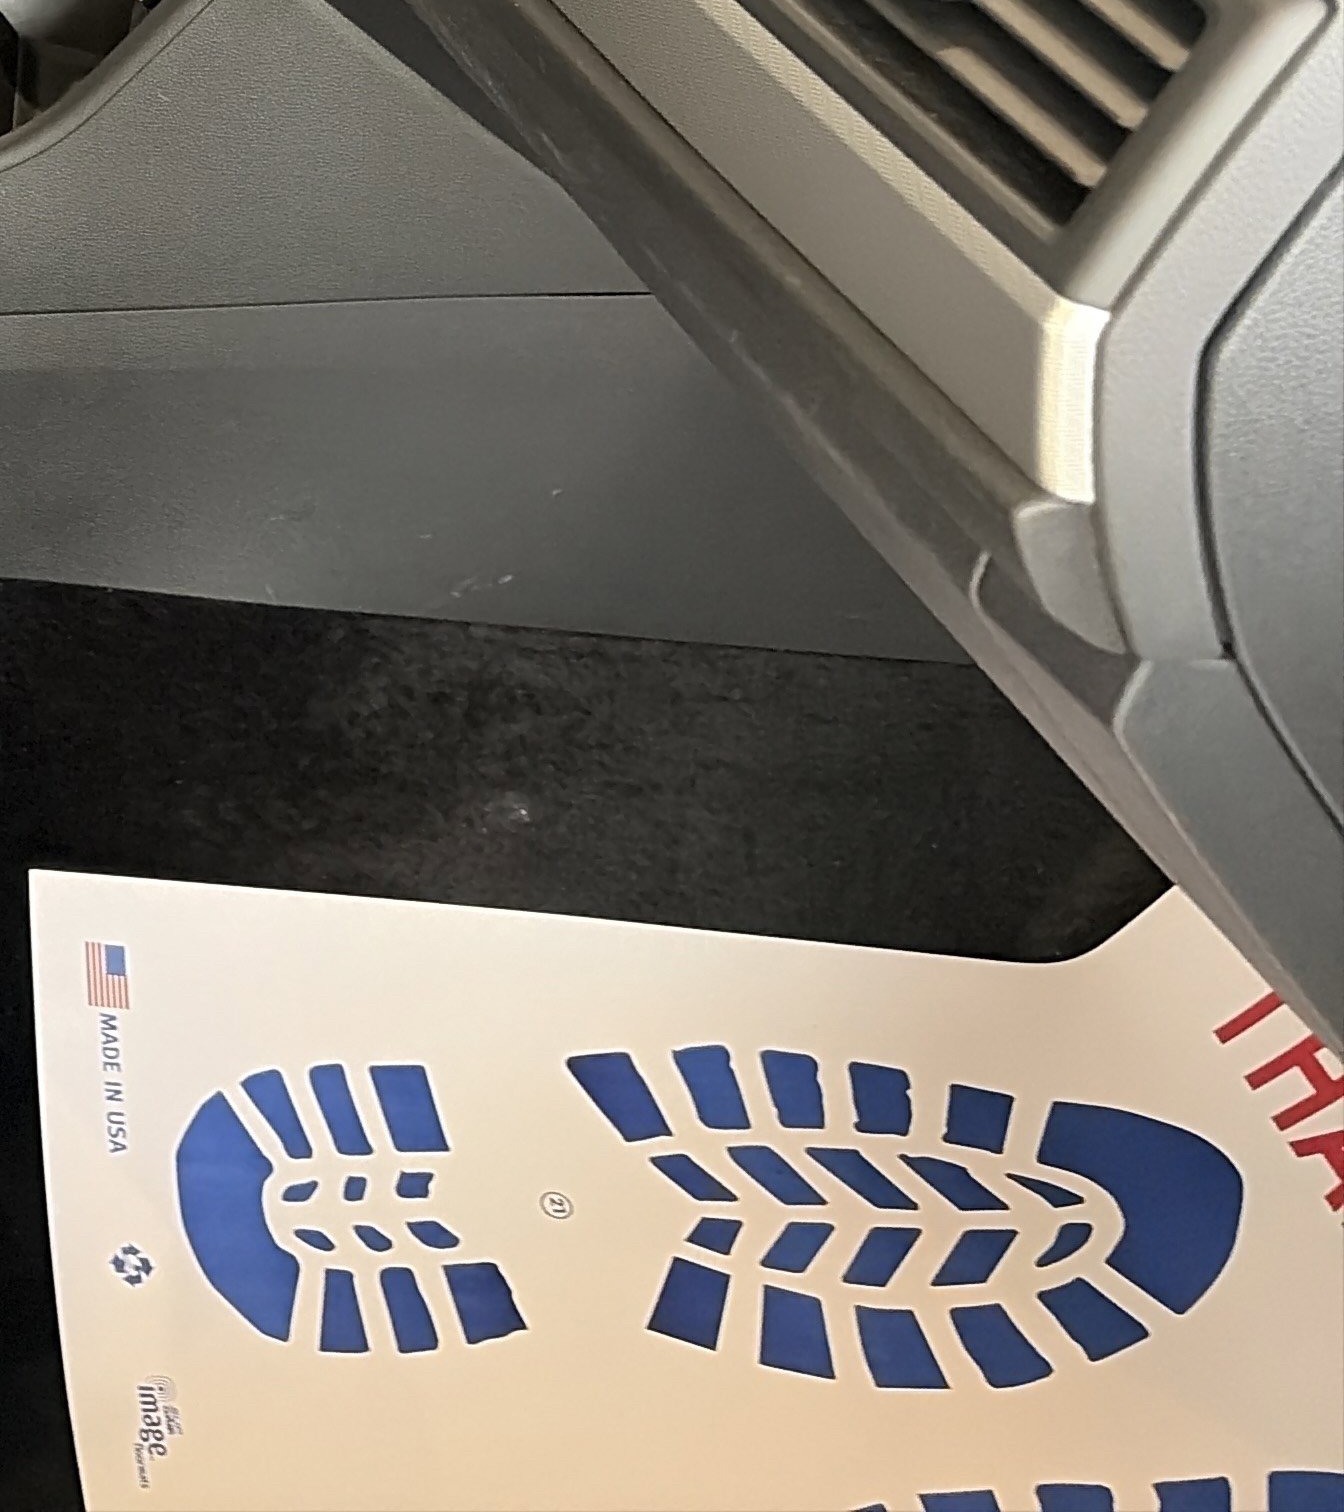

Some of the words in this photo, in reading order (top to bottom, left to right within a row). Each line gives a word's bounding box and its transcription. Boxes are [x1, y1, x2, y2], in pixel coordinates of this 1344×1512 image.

[99, 1012, 122, 1073] MADE
[104, 1081, 125, 1103] IN
[106, 1112, 128, 1154] USA
[549, 1197, 567, 1214] 21
[136, 1385, 168, 1457] image
